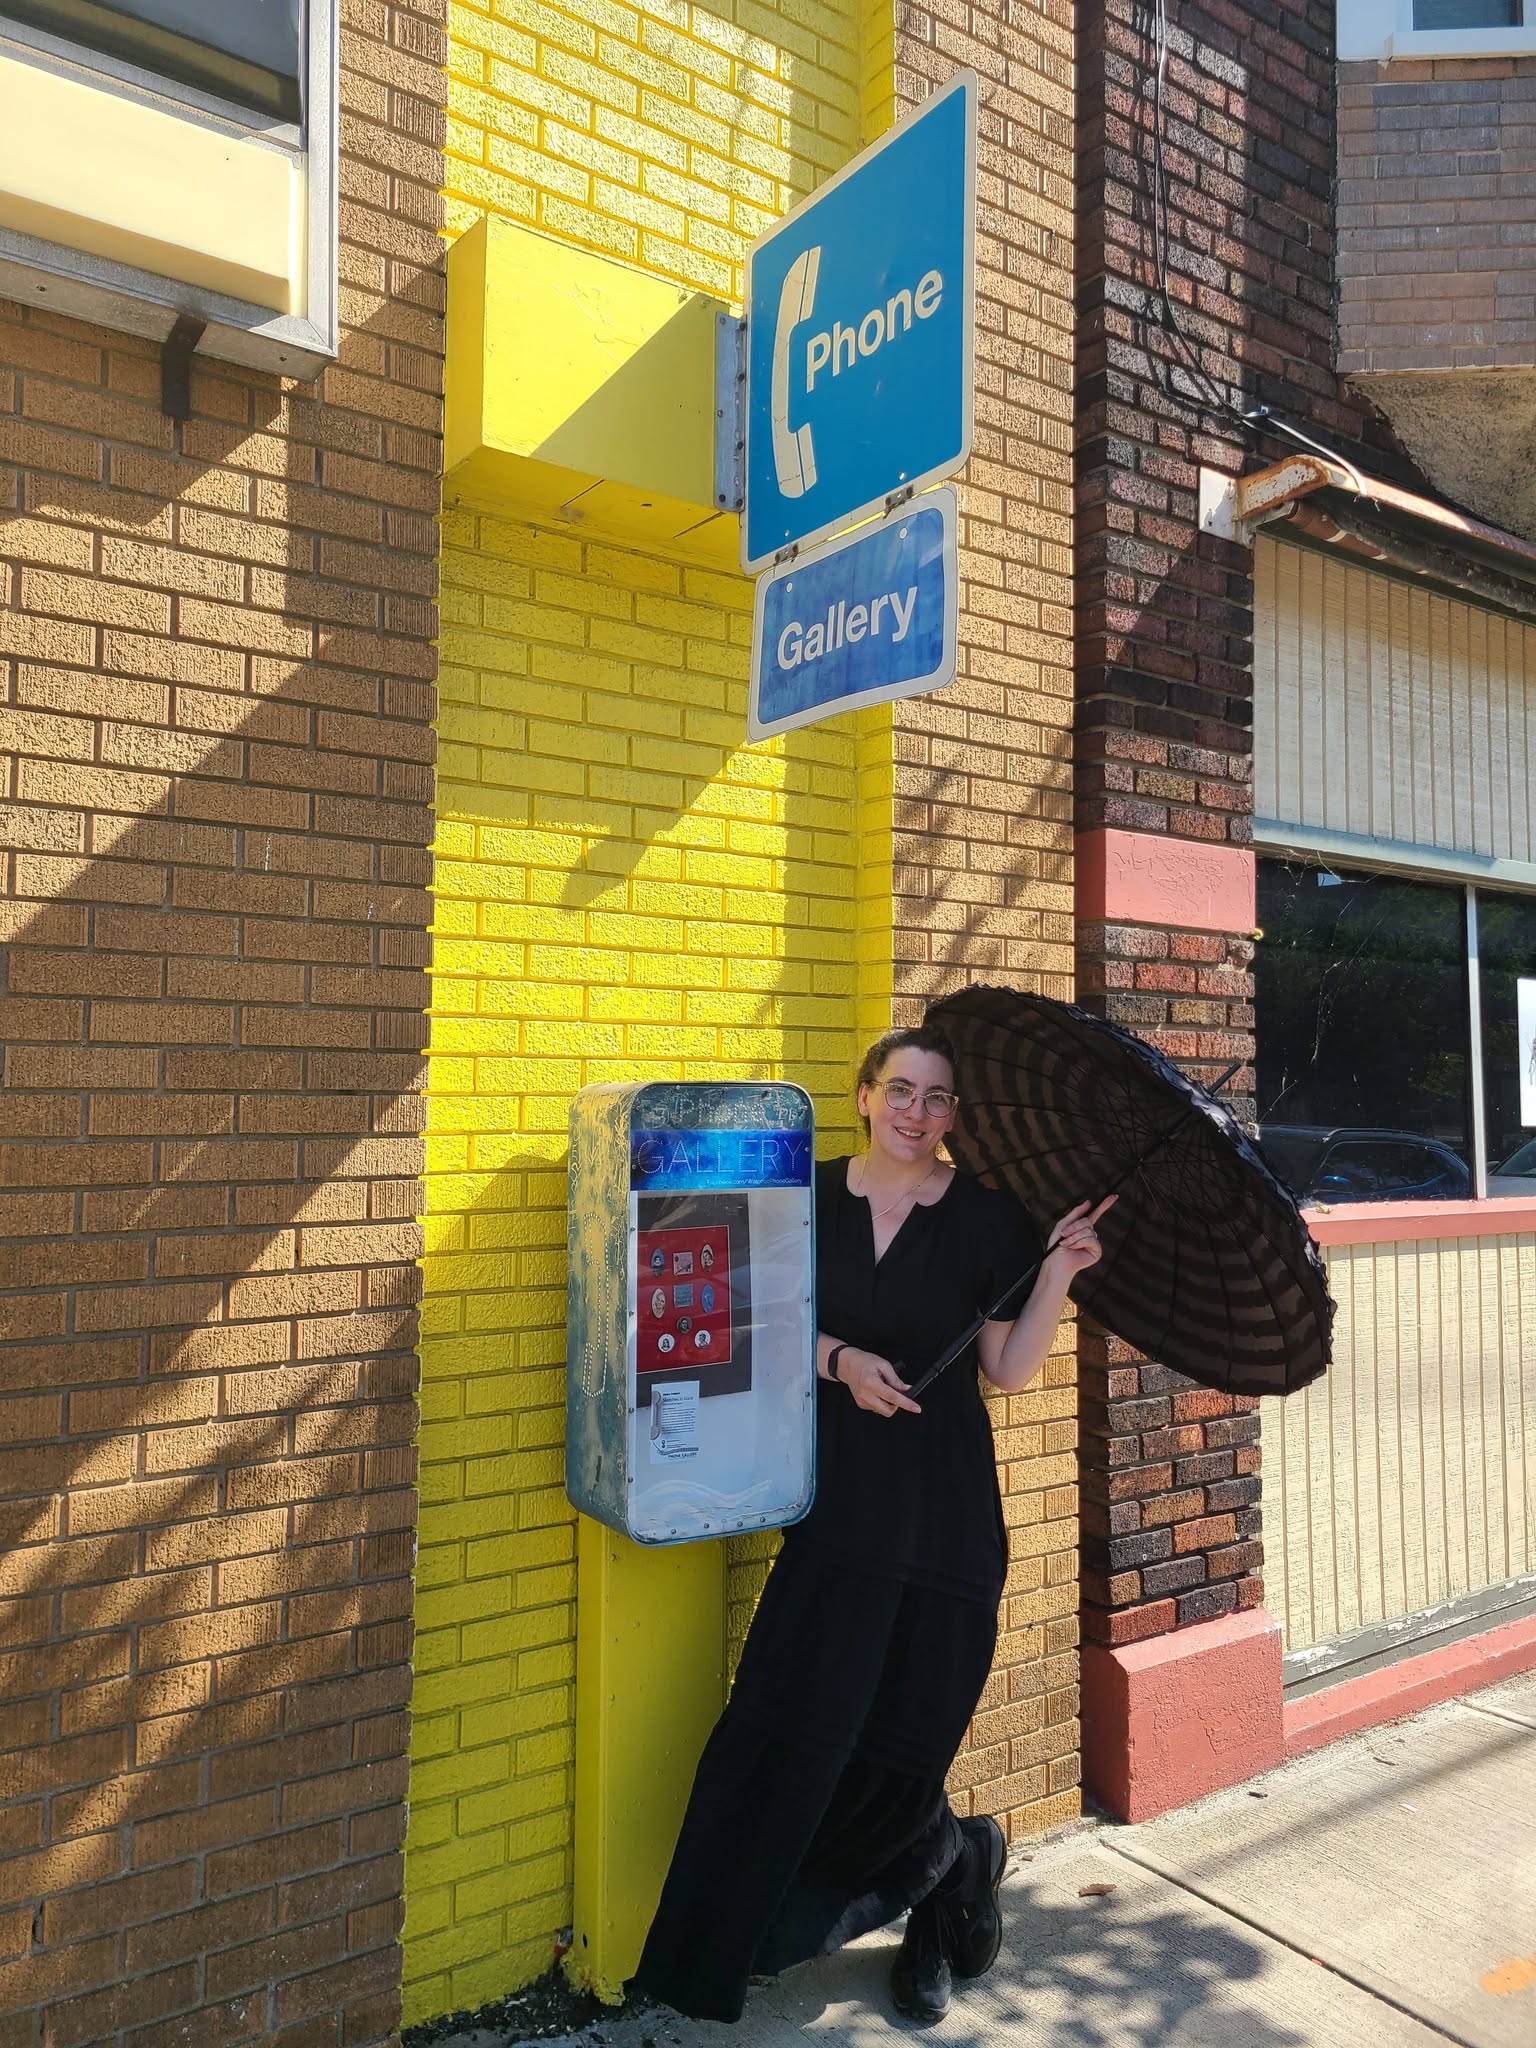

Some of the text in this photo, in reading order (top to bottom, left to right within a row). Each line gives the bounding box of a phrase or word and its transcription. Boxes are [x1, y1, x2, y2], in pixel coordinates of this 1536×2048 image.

[806, 270, 944, 393] Phone
[777, 585, 918, 670] Gallery
[637, 1139, 804, 1174] GALLERY
